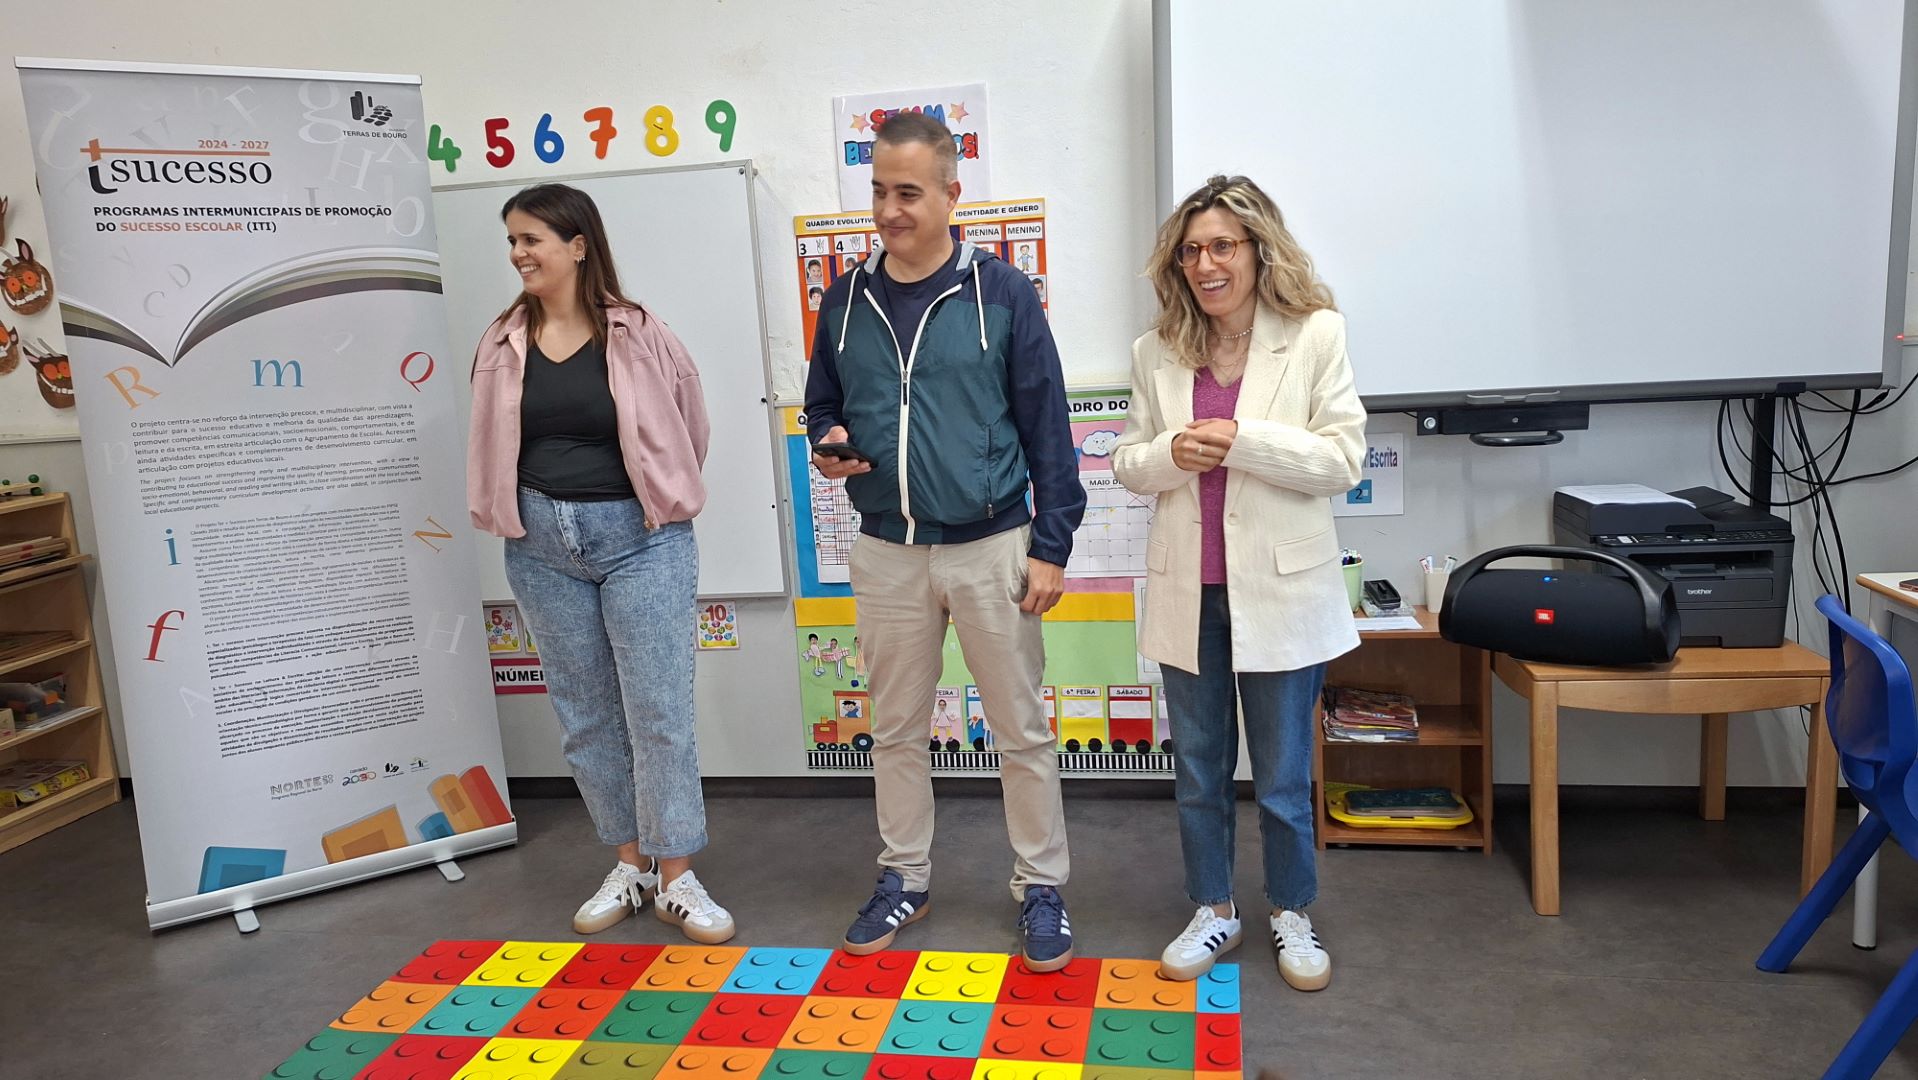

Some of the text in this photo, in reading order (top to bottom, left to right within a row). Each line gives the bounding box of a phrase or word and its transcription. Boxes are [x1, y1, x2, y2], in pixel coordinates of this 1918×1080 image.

[343, 130, 370, 138] TERRAS
[427, 99, 737, 172] 4 5 6 7 8 9
[198, 140, 228, 149] 2024
[240, 140, 269, 149] 2027
[110, 159, 272, 184] sucesso
[94, 205, 392, 218] PROGRAMAS INTERMUNICIPAIS DE PROMOÇÃO
[806, 219, 835, 228] QUADRO
[955, 207, 999, 217] IDENTIDADE
[96, 221, 277, 233] DO SUCESSO ESCOLAR (ITI)
[966, 225, 1041, 237] MENINA MENINO
[799, 239, 879, 255] 3 4 5
[251, 358, 304, 388] m
[400, 351, 434, 393] Q
[104, 365, 162, 411] R
[1068, 400, 1128, 413] DRO DO
[1370, 446, 1398, 468] Escrita
[1089, 478, 1110, 486] MAIO
[1355, 488, 1363, 500] 2
[162, 528, 182, 566] i
[491, 609, 503, 626] 5
[705, 604, 727, 622] 10
[142, 610, 185, 663] f
[270, 776, 322, 796] NORTE
[342, 771, 377, 787] 2030
